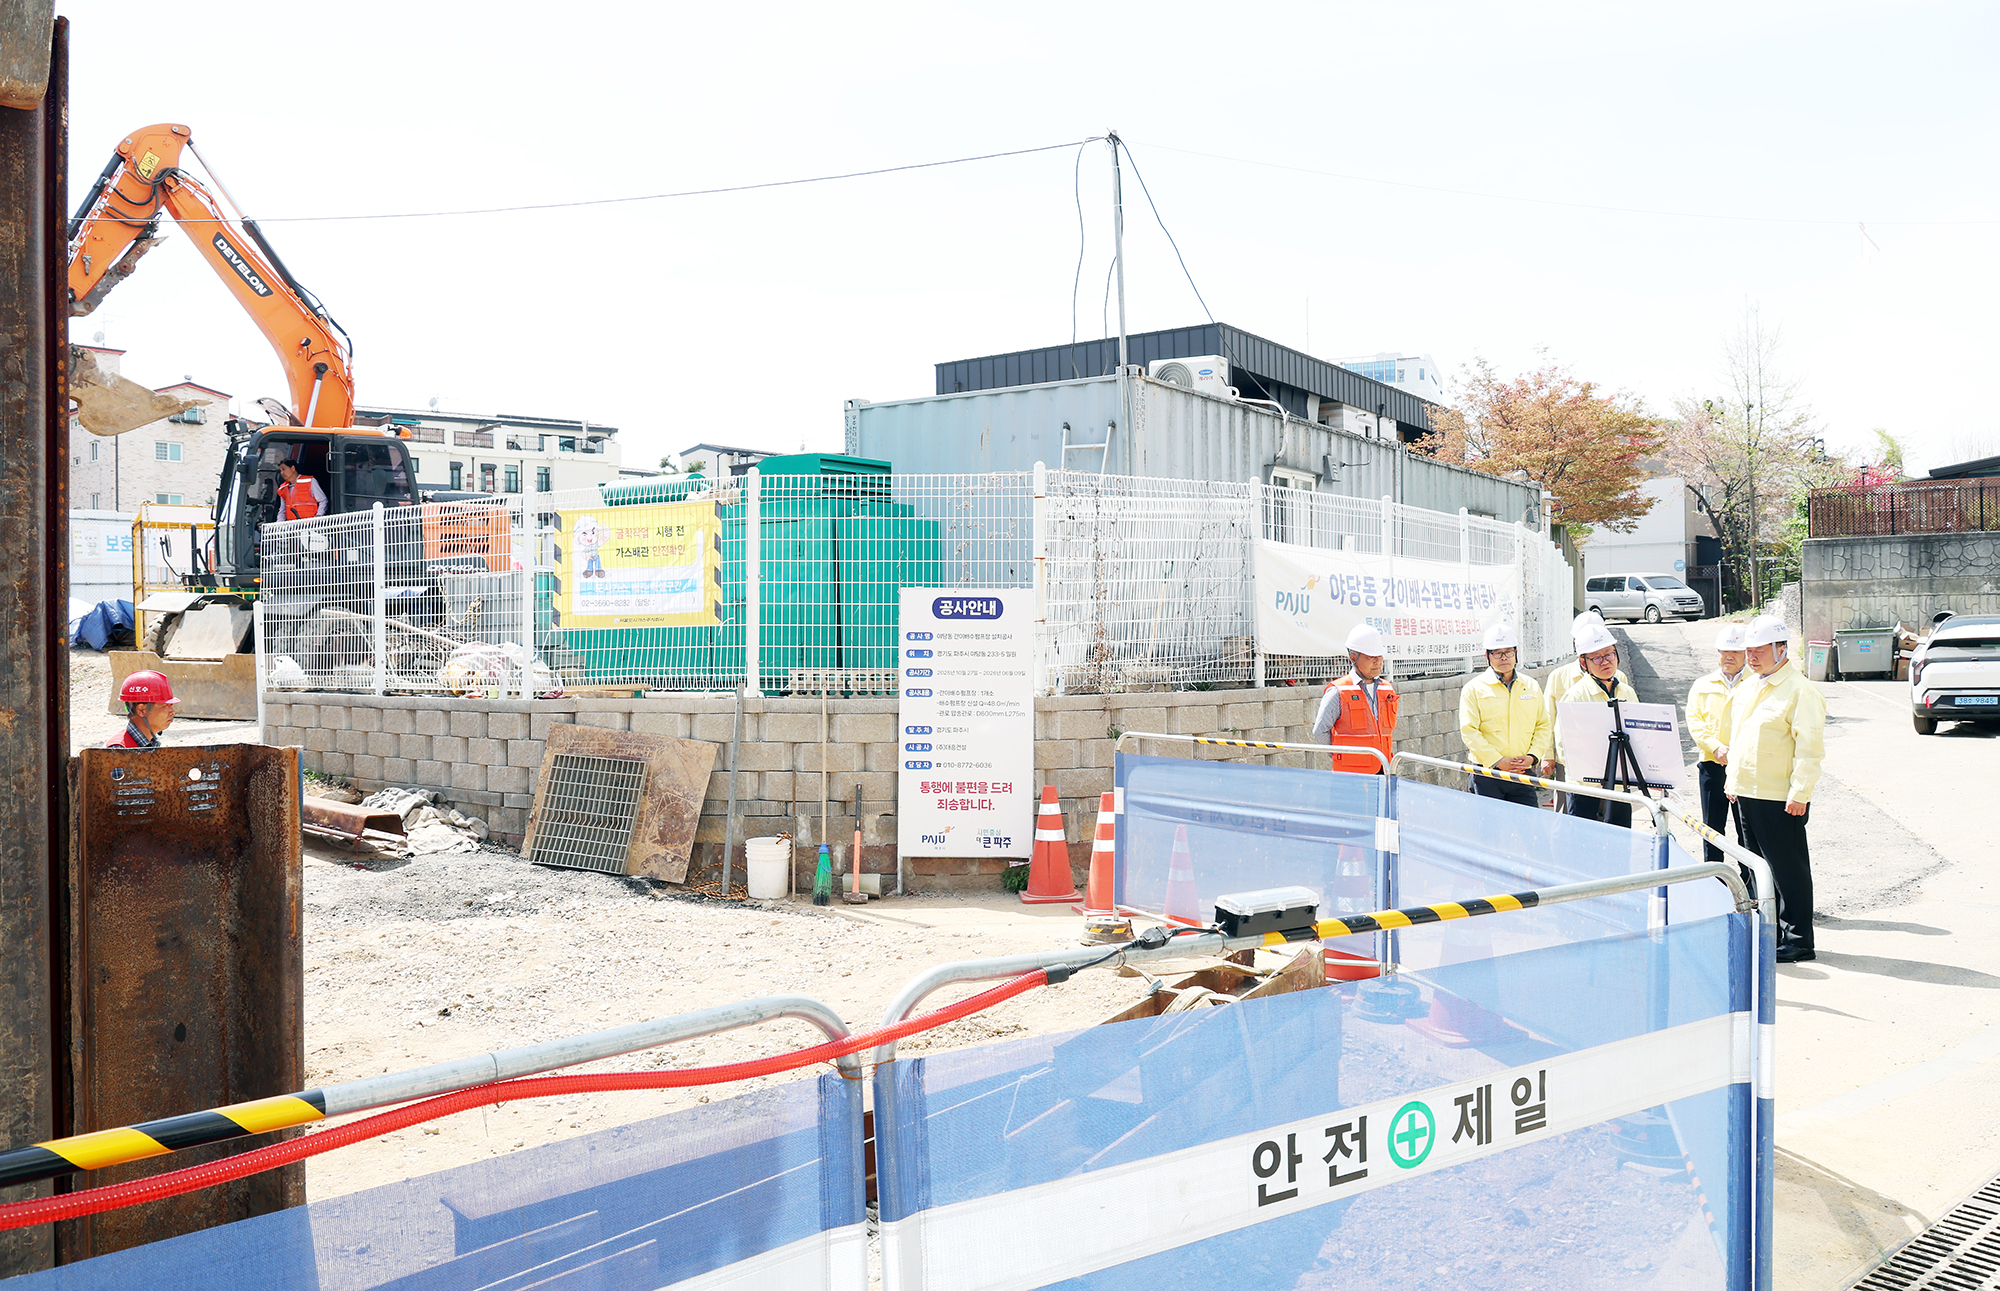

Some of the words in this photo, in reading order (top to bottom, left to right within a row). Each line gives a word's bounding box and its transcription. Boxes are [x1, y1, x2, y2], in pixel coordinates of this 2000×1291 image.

[215, 238, 268, 295] DEVELON
[656, 526, 673, 537] 시행
[675, 525, 685, 536] 전
[616, 546, 650, 558] 가스배관
[652, 544, 686, 557] 안전확인
[1329, 574, 1377, 607] 야당동
[1382, 577, 1460, 610] 간이배수펌프장
[1464, 584, 1496, 610] 설치공사
[939, 600, 997, 616] 공사안내
[1276, 590, 1310, 616] PAJU
[1394, 618, 1418, 636] 불편을
[1420, 618, 1433, 635] 드려
[1435, 618, 1454, 636] 대단히
[920, 781, 953, 794] 통행에
[955, 781, 989, 794] 불편을
[990, 782, 1013, 794] 드려
[937, 798, 995, 811] 죄송합니다.
[922, 835, 946, 845] PAJU
[983, 837, 992, 848] 큰
[994, 837, 1012, 848] 파주
